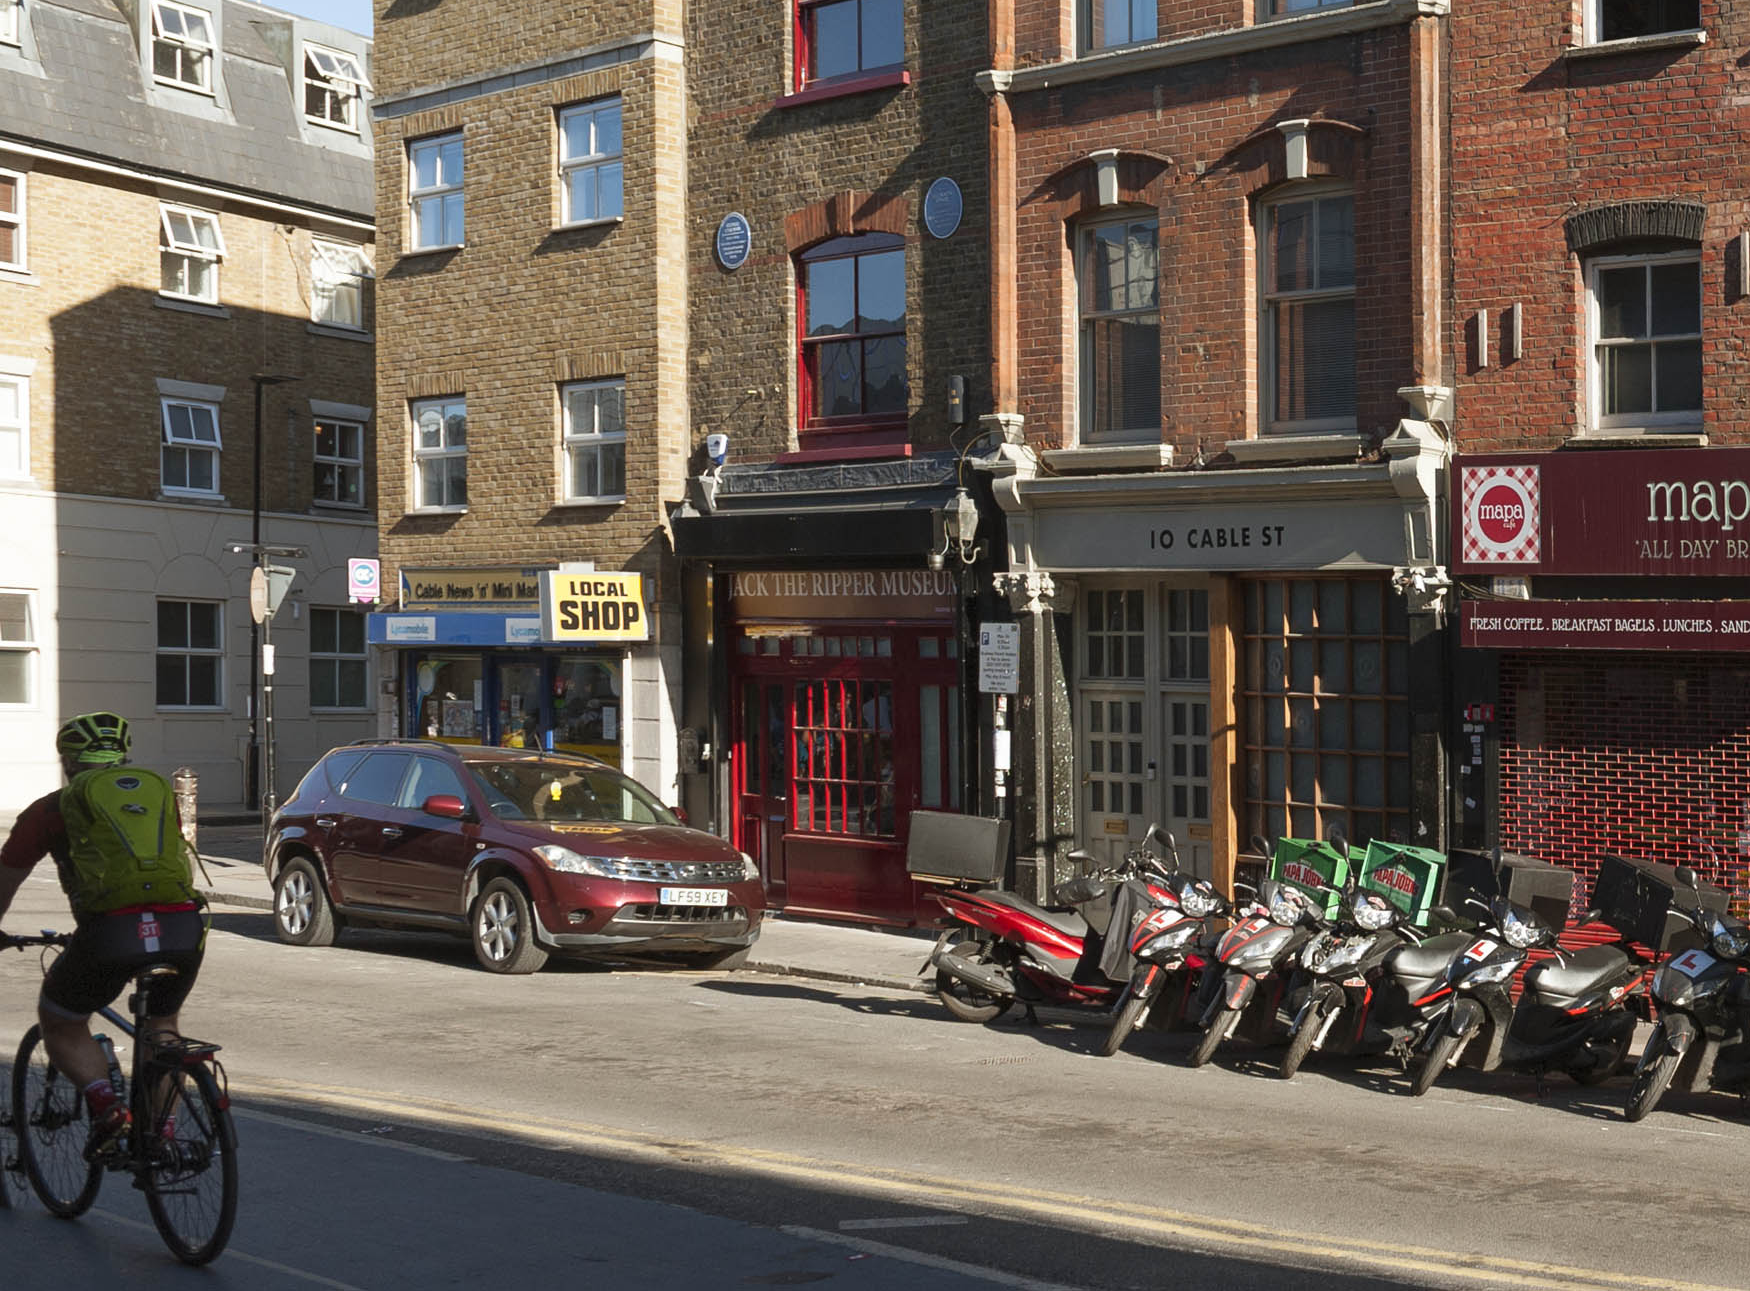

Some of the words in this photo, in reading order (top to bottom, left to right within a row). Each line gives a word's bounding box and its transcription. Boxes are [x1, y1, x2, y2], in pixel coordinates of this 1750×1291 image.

[1480, 503, 1524, 523] mapa
[1187, 527, 1251, 549] CABLE
[1262, 526, 1285, 547] ST
[415, 582, 443, 599] Cable
[446, 582, 474, 598] News
[491, 581, 513, 598] Mini
[569, 580, 629, 597] LOCAL
[727, 572, 769, 601] JACK
[771, 572, 808, 596] THE
[812, 571, 877, 596] RIPPER
[559, 600, 640, 631] SHOP
[1470, 617, 1502, 631] FRESH
[1504, 617, 1545, 631] COFFEE
[1552, 618, 1613, 632] BREAKFAST
[1615, 618, 1655, 632] BAGELS
[1663, 619, 1713, 633] LUNCHES
[1283, 863, 1301, 882] PAPA
[1373, 868, 1391, 888] PAPA
[670, 891, 701, 903] LF59
[704, 891, 726, 904] XEY
[141, 923, 158, 936] 3T
[1470, 941, 1485, 957] L
[1680, 953, 1697, 971] L
